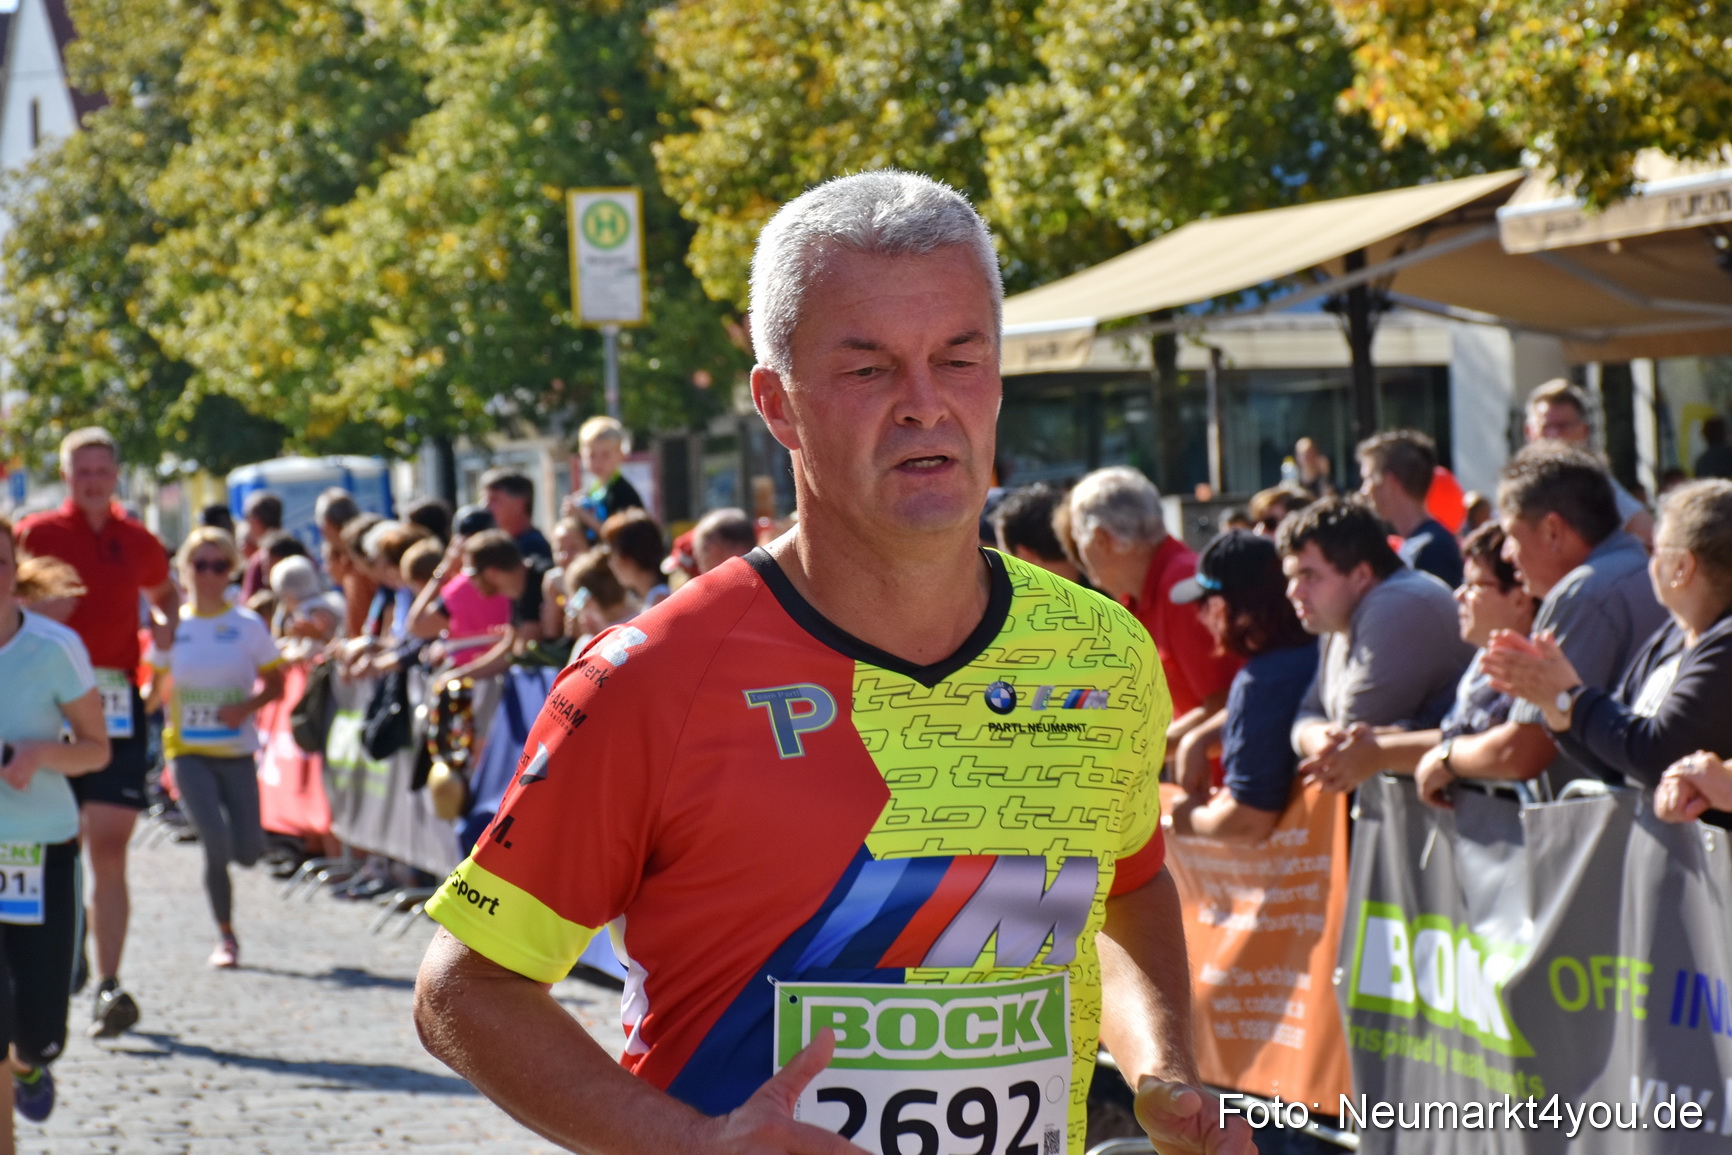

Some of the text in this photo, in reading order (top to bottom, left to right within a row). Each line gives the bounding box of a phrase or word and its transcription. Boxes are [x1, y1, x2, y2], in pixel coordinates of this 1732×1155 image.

[988, 722, 1087, 733] PARTL NEUMARKT
[807, 994, 1047, 1054] BOCK
[816, 1080, 1041, 1155] 2692
